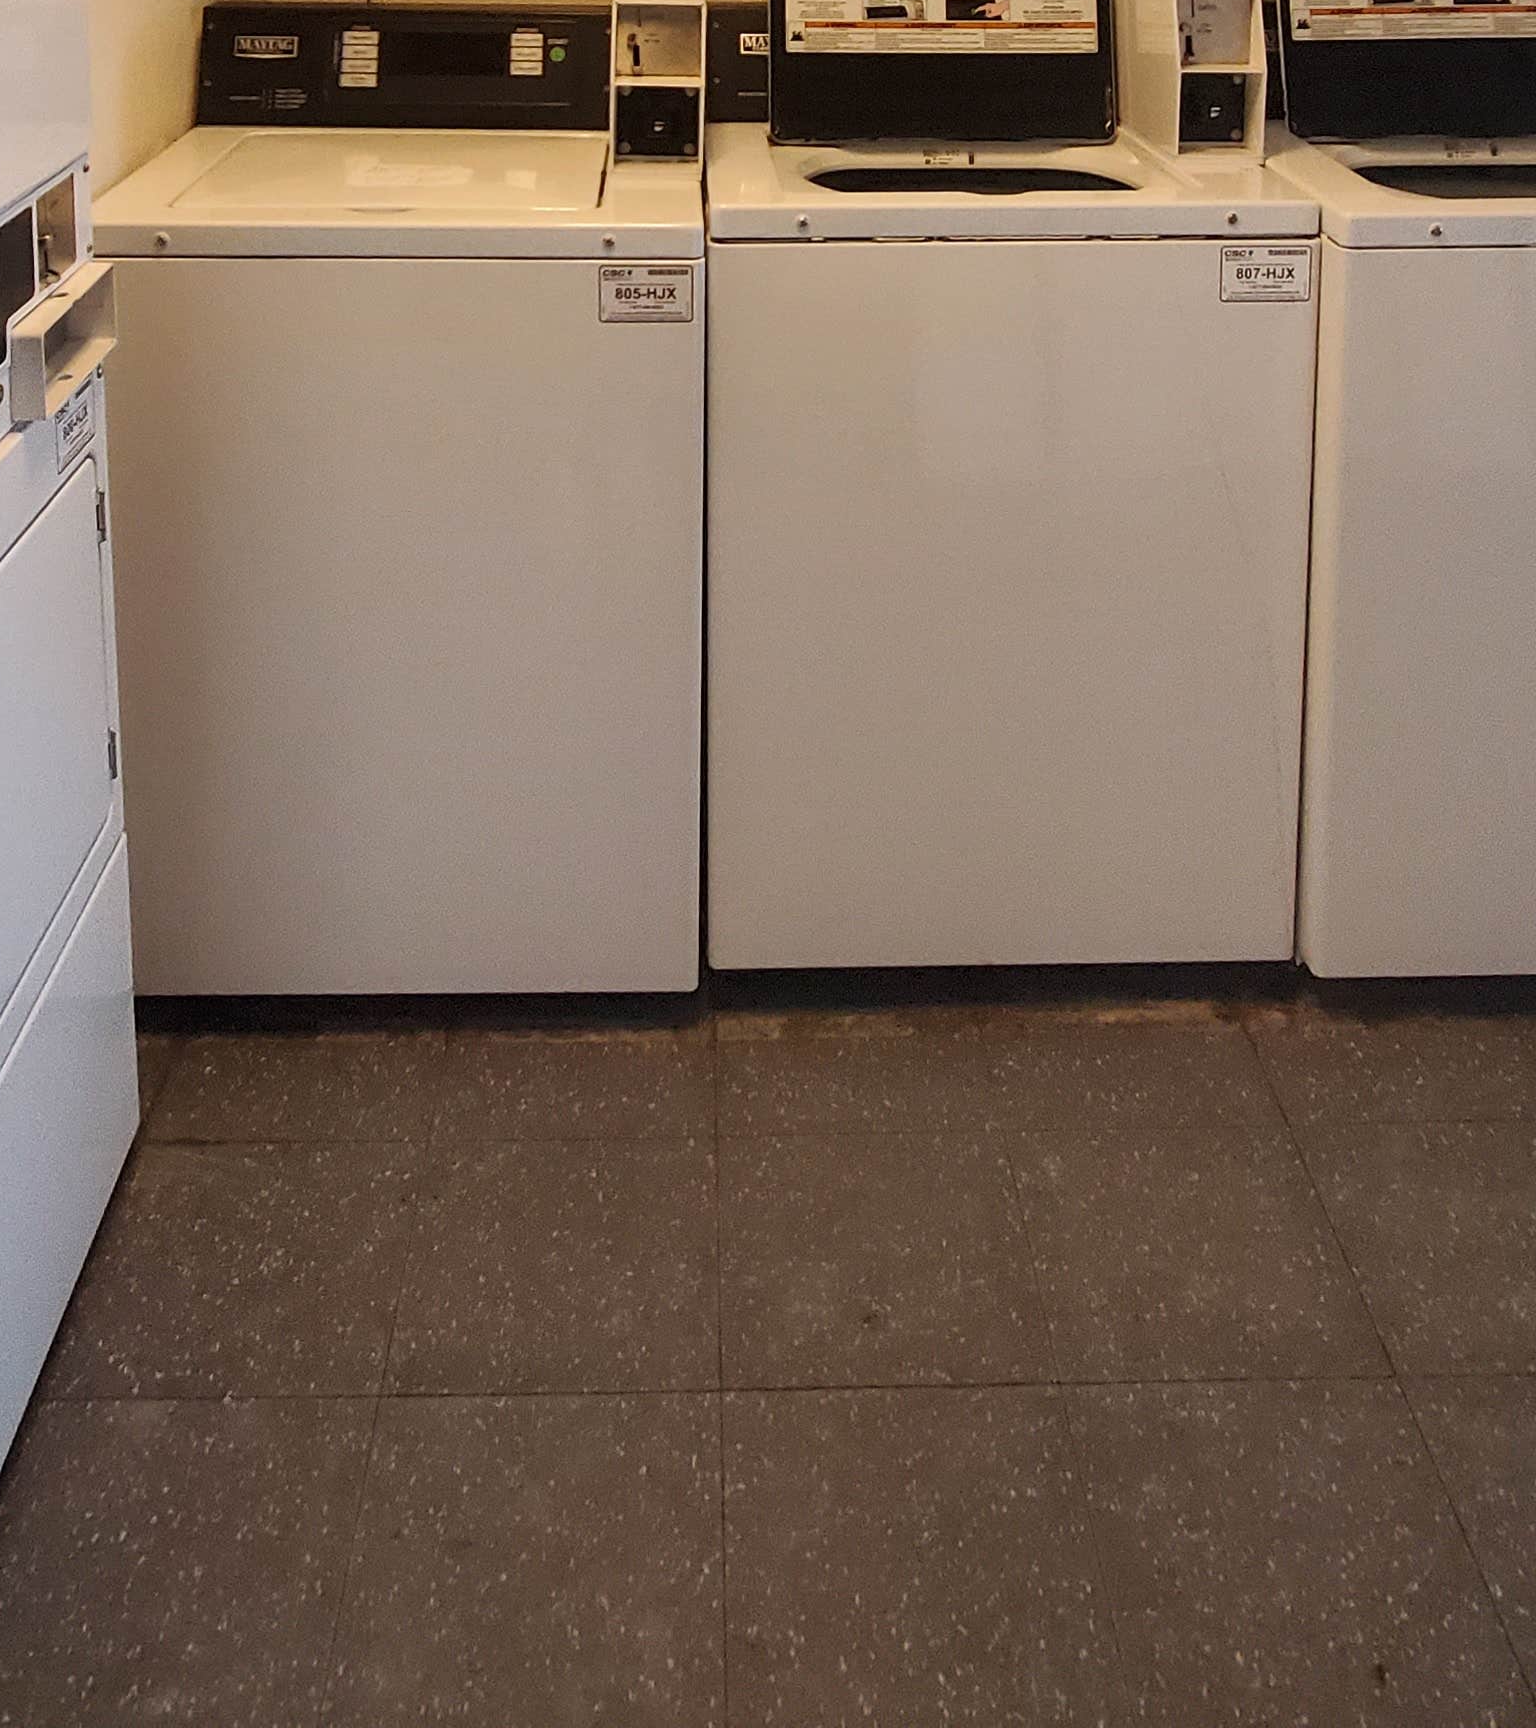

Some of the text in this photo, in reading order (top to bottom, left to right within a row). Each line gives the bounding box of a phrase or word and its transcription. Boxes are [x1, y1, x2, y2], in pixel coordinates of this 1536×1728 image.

[238, 39, 294, 50] MAYTAG
[1236, 267, 1295, 280] 807-HJX
[615, 287, 677, 300] 805-HJX
